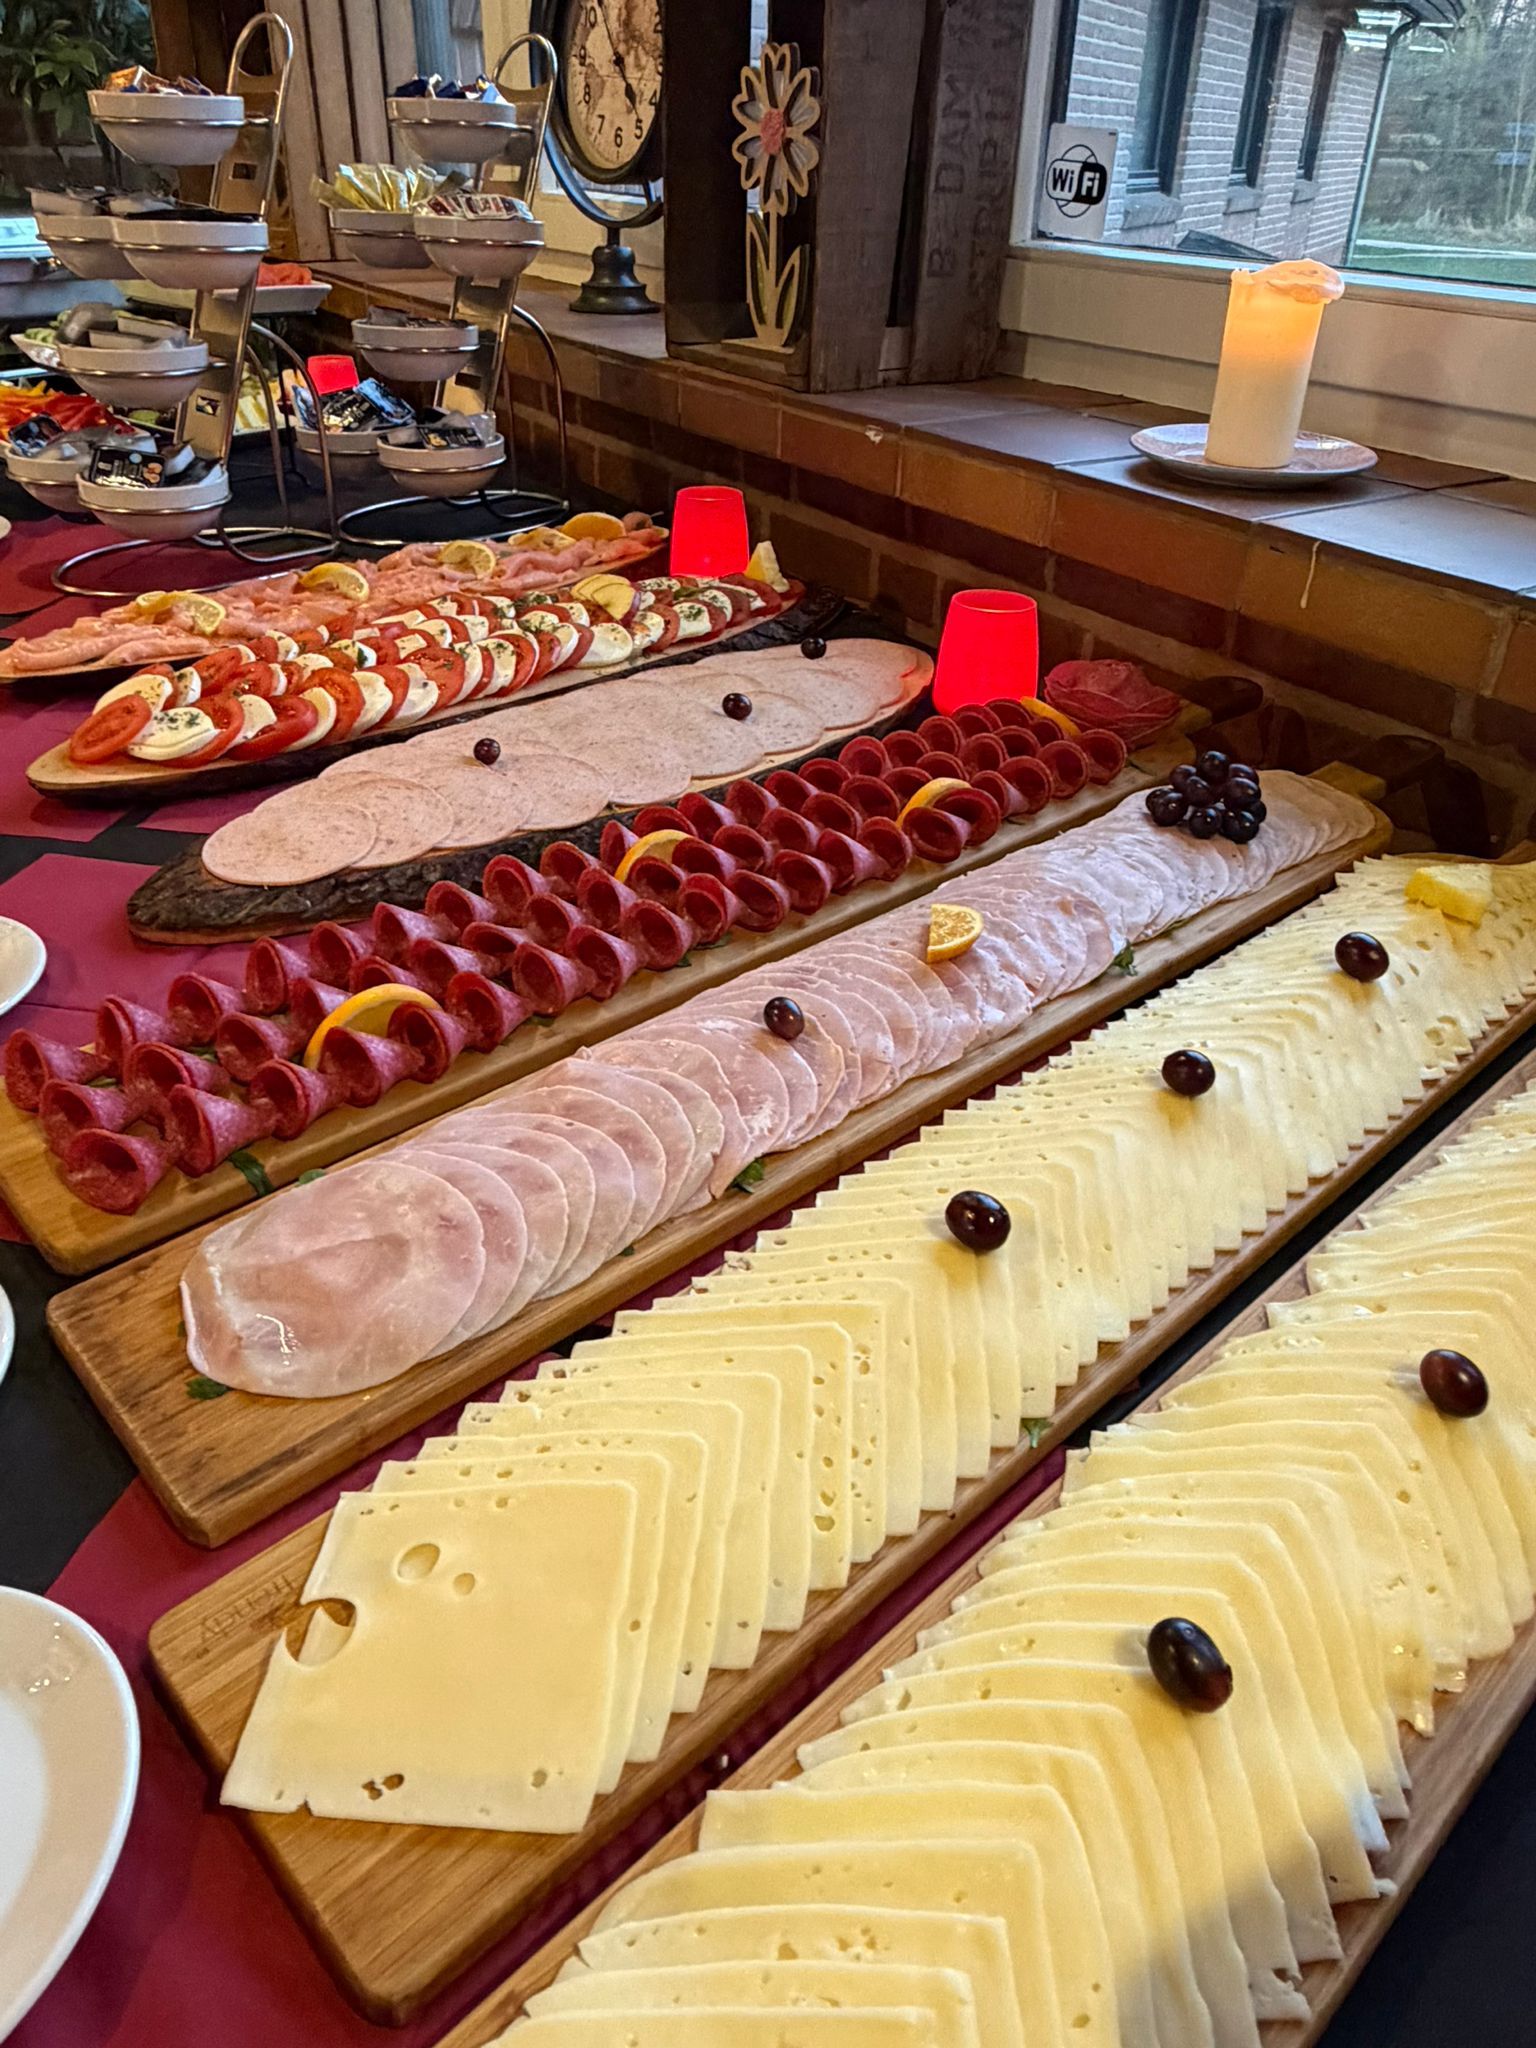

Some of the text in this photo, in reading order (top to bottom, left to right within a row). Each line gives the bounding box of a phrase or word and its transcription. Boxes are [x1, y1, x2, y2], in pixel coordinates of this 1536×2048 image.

[579, 45, 587, 66] 9
[583, 83, 591, 105] 8
[648, 89, 661, 106] 4
[597, 114, 605, 135] 7
[633, 118, 643, 140] 5
[614, 126, 623, 148] 6
